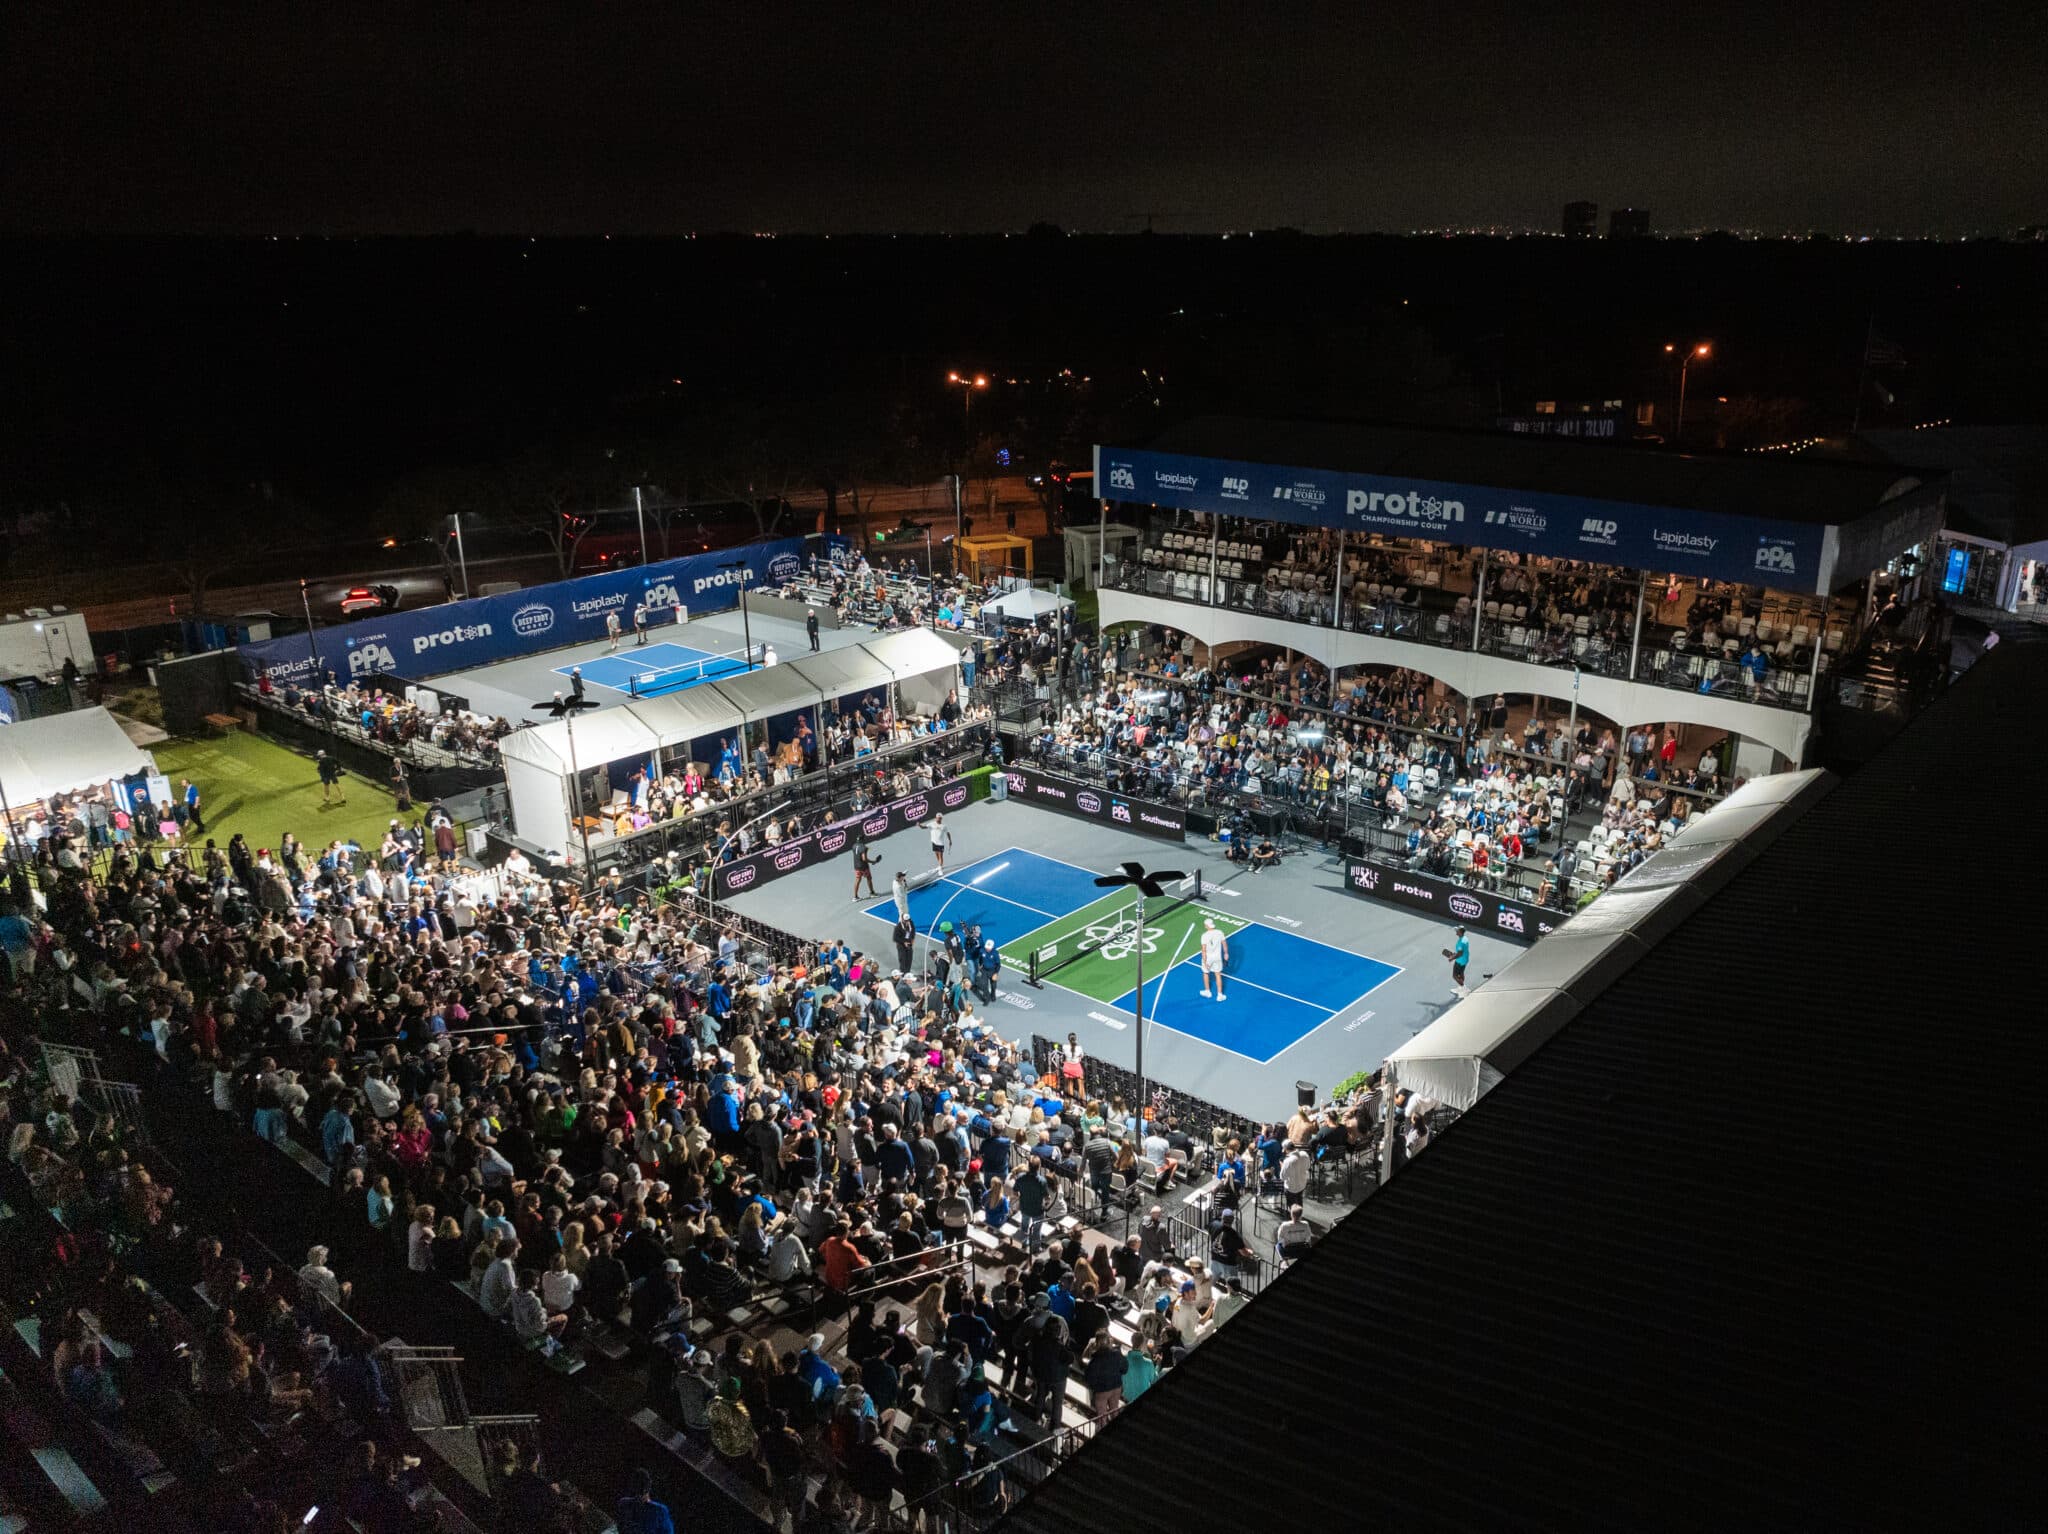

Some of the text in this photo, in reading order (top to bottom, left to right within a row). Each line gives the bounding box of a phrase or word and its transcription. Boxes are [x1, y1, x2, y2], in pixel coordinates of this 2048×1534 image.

[1110, 468, 1134, 487] PPA
[1155, 470, 1198, 487] Lapiplasty
[1222, 477, 1249, 494] MLP
[1294, 491, 1326, 501] WORLD
[1346, 489, 1465, 522] proton
[1361, 514, 1447, 531] CHAMPIONSHIP COURT
[1509, 514, 1547, 527] WORLD
[1582, 518, 1618, 537] MLP
[1653, 529, 1717, 550] Lapiplasty
[1755, 546, 1795, 569] PPA
[693, 568, 754, 594] proton
[572, 592, 628, 612] Lapiplasty
[645, 583, 680, 609] PPA
[517, 613, 549, 626] DEEP EDDY
[357, 633, 387, 644] CARVANA
[413, 623, 493, 654] proton
[348, 643, 396, 673] PPA
[1037, 785, 1066, 798] proton
[1112, 806, 1131, 822] PPA
[1140, 812, 1176, 829] Southwest
[1394, 882, 1433, 900] proton
[1199, 910, 1245, 926] proton
[1498, 912, 1524, 931] PPA
